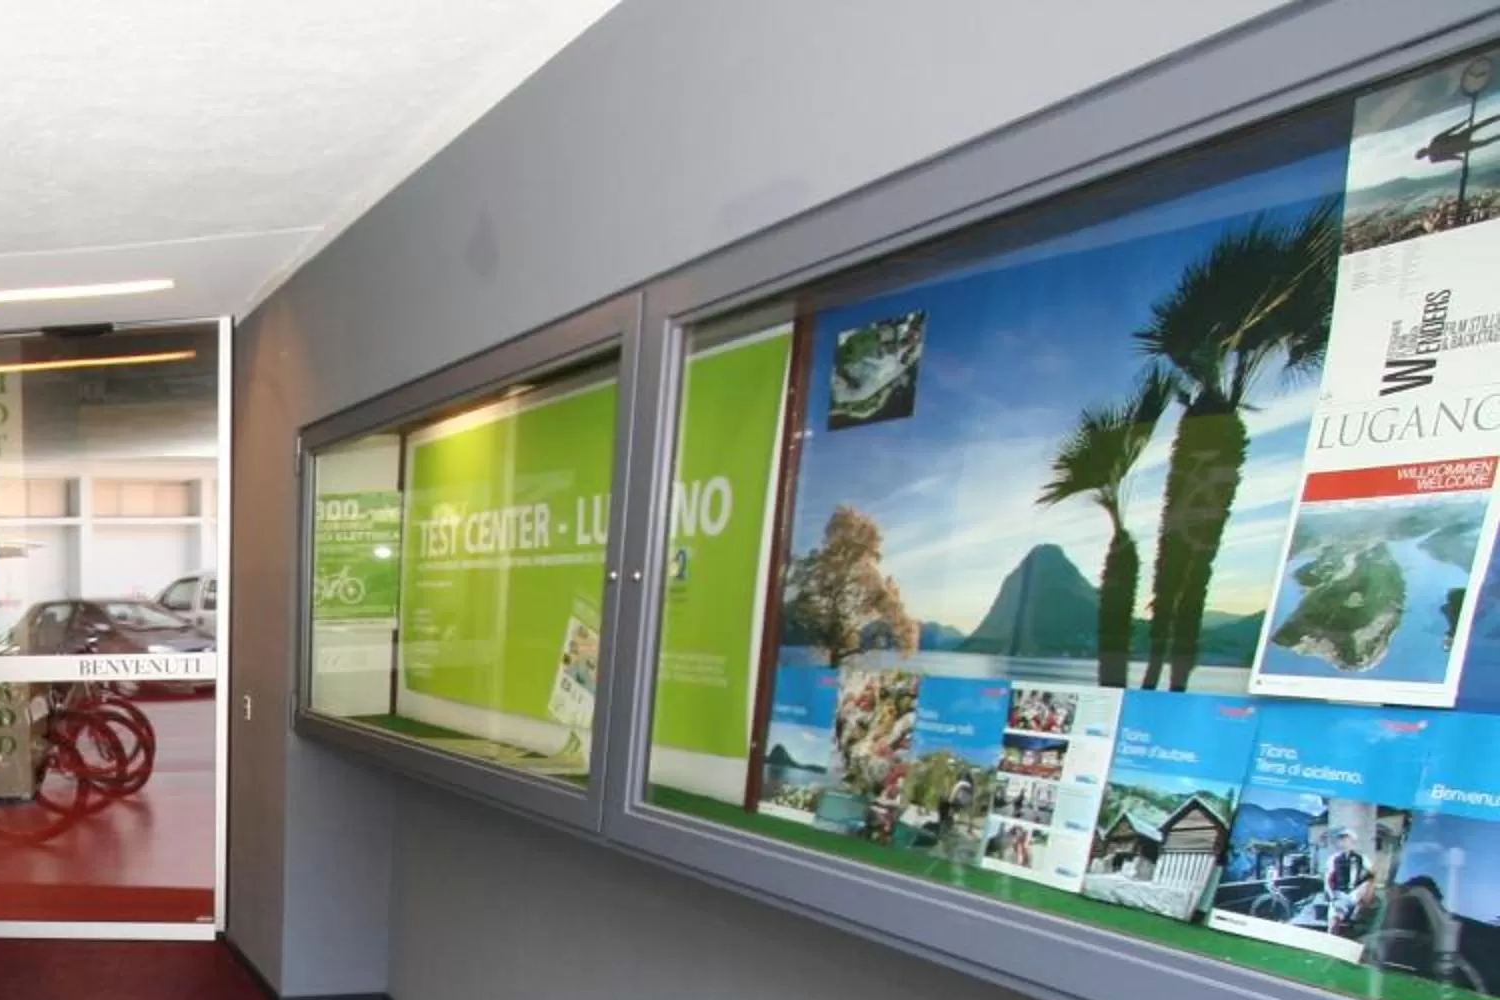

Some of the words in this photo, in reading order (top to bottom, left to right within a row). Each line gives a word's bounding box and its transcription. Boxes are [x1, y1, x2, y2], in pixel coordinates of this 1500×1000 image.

[1397, 461, 1494, 480] WILLKOMMEN
[1416, 475, 1489, 490] WELCOME
[417, 519, 459, 559] TEST
[463, 503, 550, 554] CENTER
[78, 657, 202, 677] BENVENUTI
